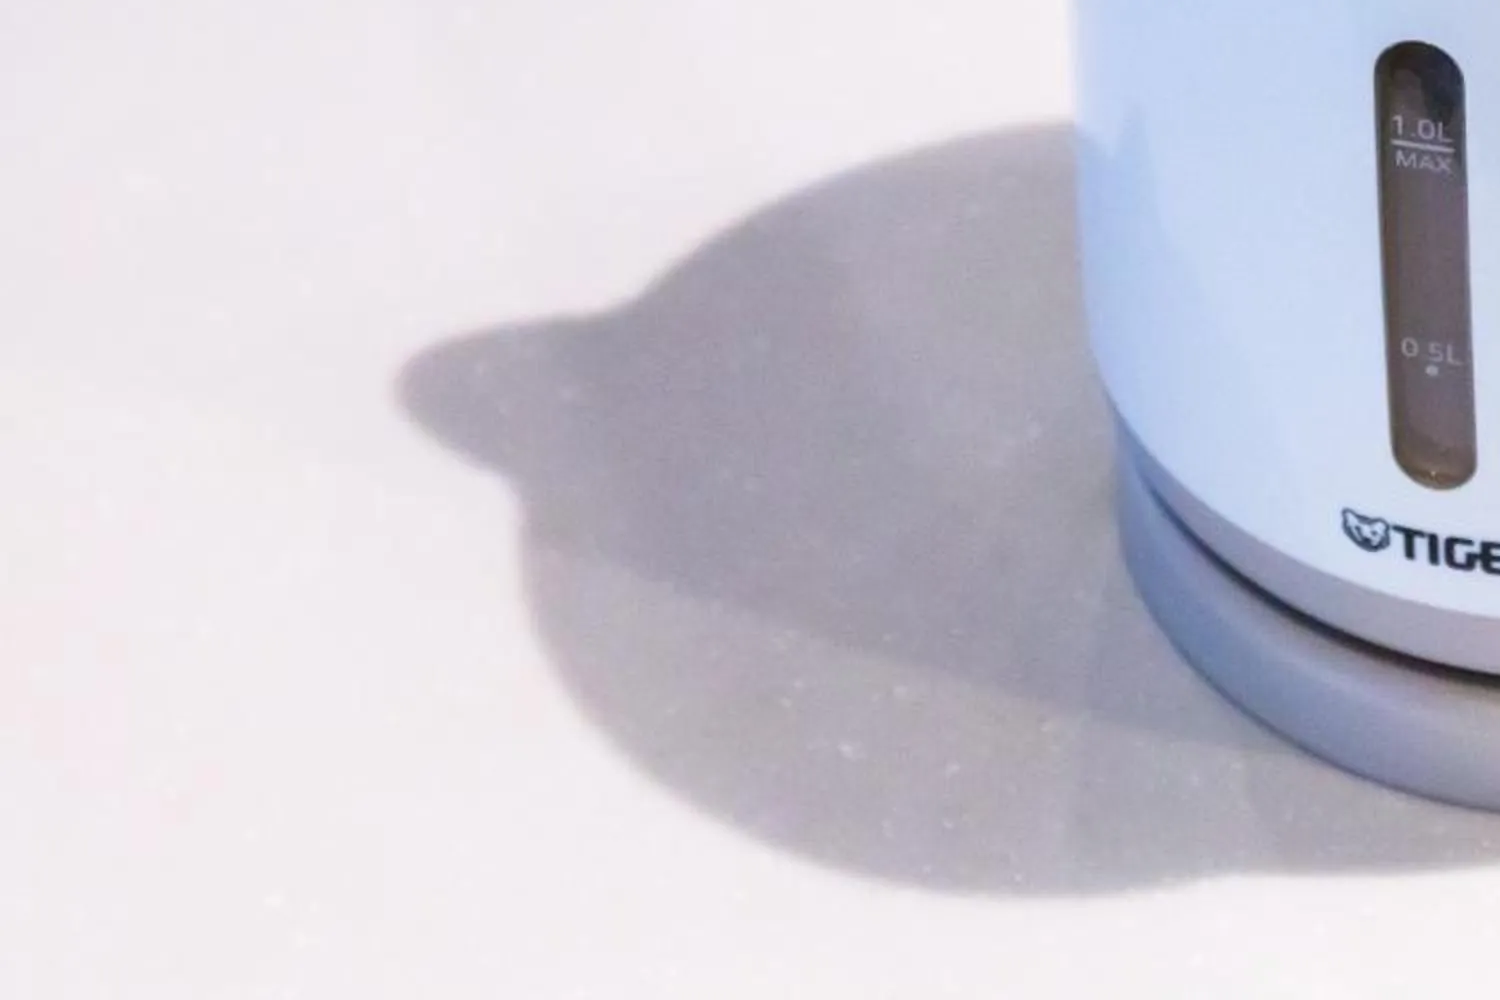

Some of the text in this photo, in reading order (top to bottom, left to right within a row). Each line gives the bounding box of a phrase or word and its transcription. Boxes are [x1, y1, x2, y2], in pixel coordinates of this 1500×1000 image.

[1391, 114, 1454, 143] 1.0L
[1396, 149, 1456, 174] MAX
[1401, 336, 1463, 366] 05L
